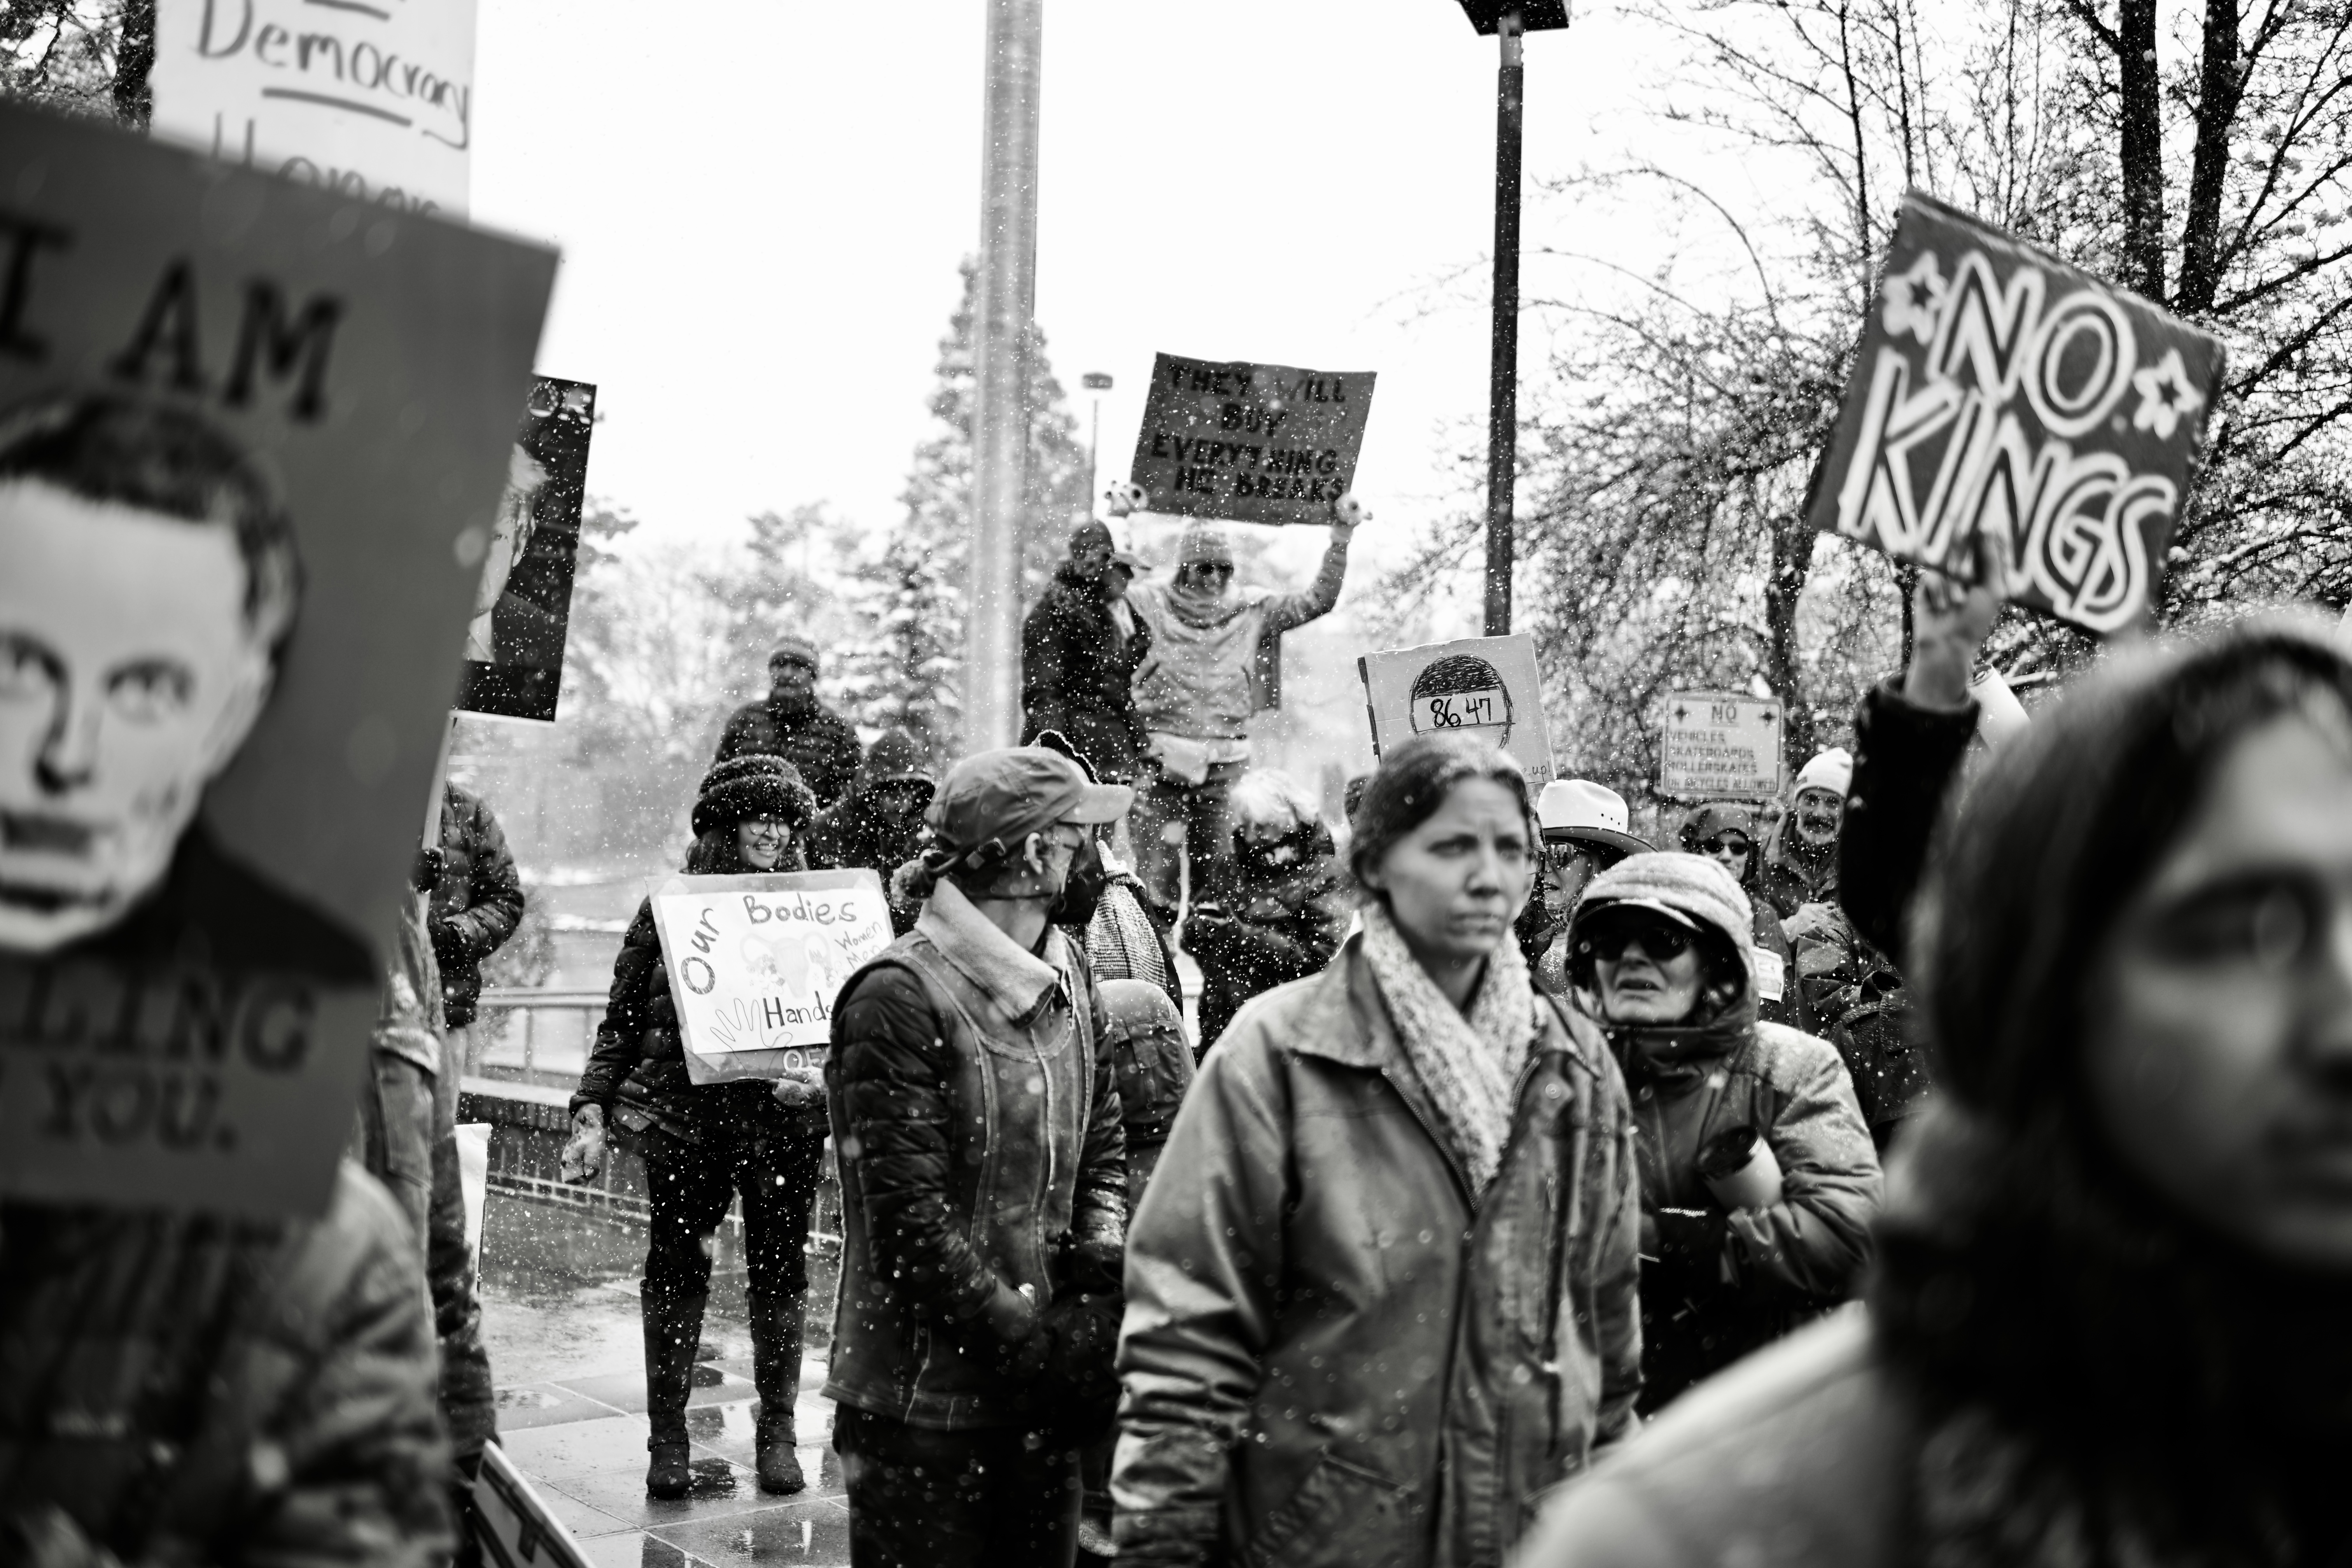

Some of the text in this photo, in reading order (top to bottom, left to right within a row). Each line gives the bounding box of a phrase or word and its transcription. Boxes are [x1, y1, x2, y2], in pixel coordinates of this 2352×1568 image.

[197, 0, 471, 150] Democracy
[109, 252, 347, 423] AM
[1926, 249, 2137, 438] NO
[1168, 363, 1345, 403] THEY WILL
[1221, 403, 1288, 437] BUY
[1151, 432, 1337, 475] EVERYTHING
[1174, 466, 1344, 503] HE BREAKS
[1838, 346, 2177, 634] KINGS
[1430, 697, 1491, 727] 86 47
[1712, 705, 1736, 722] NO
[1670, 731, 1725, 742] VEHICLES
[1670, 747, 1754, 759] SKATEBOARDS
[1532, 755, 1552, 782] up!
[1669, 762, 1757, 774] ROLLERSKATES
[1685, 778, 1728, 789] BICYCLES
[1732, 779, 1776, 790] ALLOWED
[681, 893, 857, 995] Our Bodies
[834, 921, 882, 950] Women
[36, 1059, 239, 1153] YOU.
